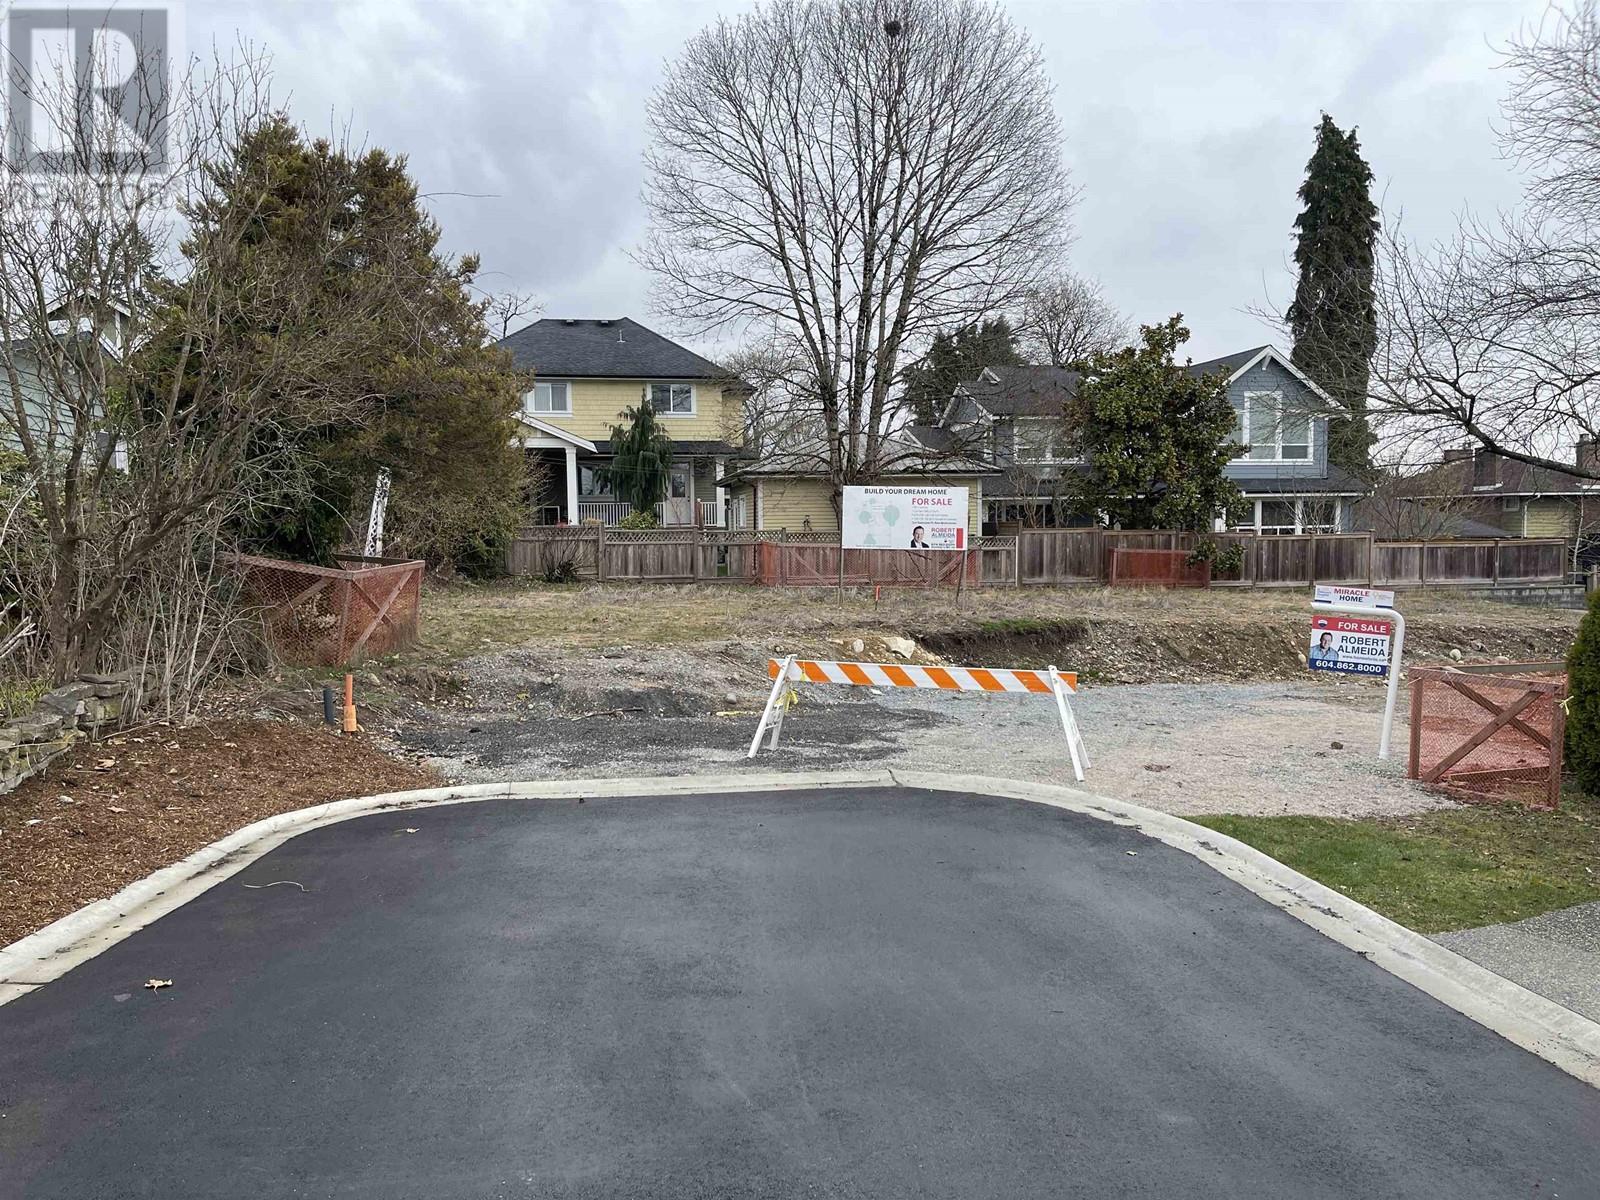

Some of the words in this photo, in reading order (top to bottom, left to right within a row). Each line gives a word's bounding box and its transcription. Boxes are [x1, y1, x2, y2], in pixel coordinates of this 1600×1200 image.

[911, 498, 930, 506] FOR
[931, 498, 953, 506] SALE
[1333, 588, 1370, 597] MIRACLE
[1339, 595, 1364, 603] HOME
[1337, 621, 1358, 631] FOR
[1360, 624, 1387, 633] SALE
[1341, 635, 1387, 647] ROBERT
[1337, 644, 1386, 657] ALMEIDA
[1315, 658, 1382, 673] 604.862.8000
